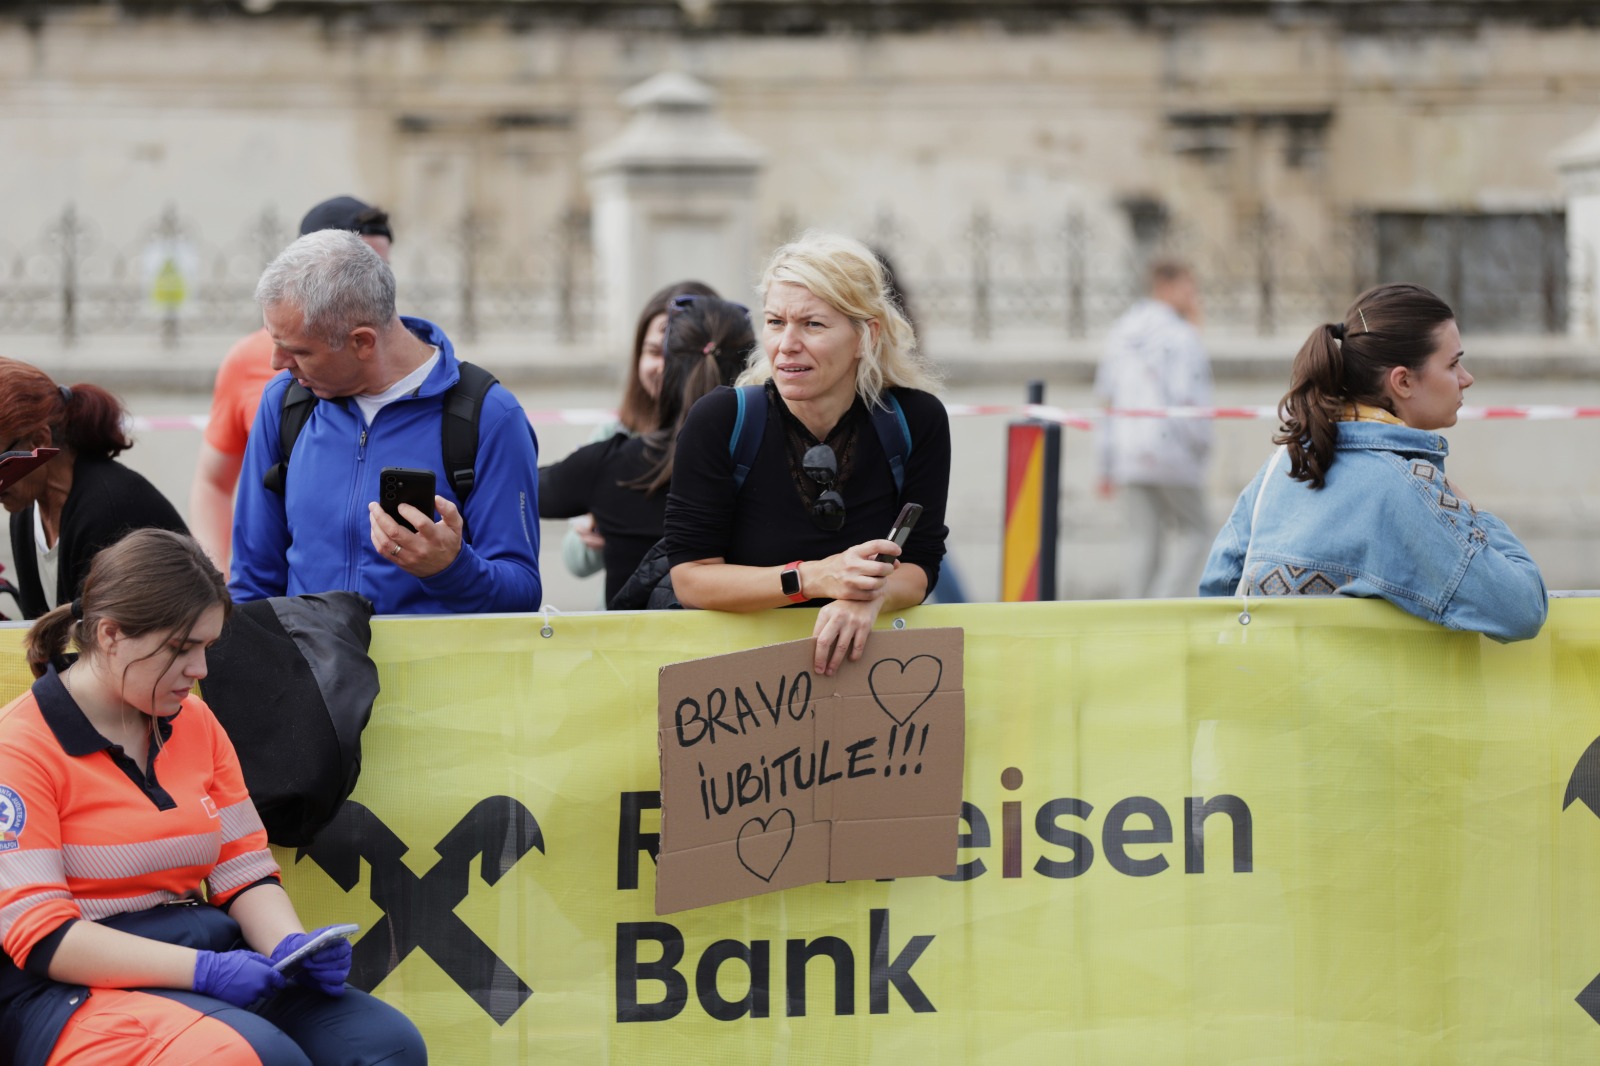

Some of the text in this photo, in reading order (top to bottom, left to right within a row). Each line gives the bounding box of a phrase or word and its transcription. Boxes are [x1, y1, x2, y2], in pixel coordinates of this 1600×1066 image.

[675, 671, 815, 747] BRAVO,
[617, 767, 1253, 890] Reisen
[615, 909, 937, 1024] Bank
